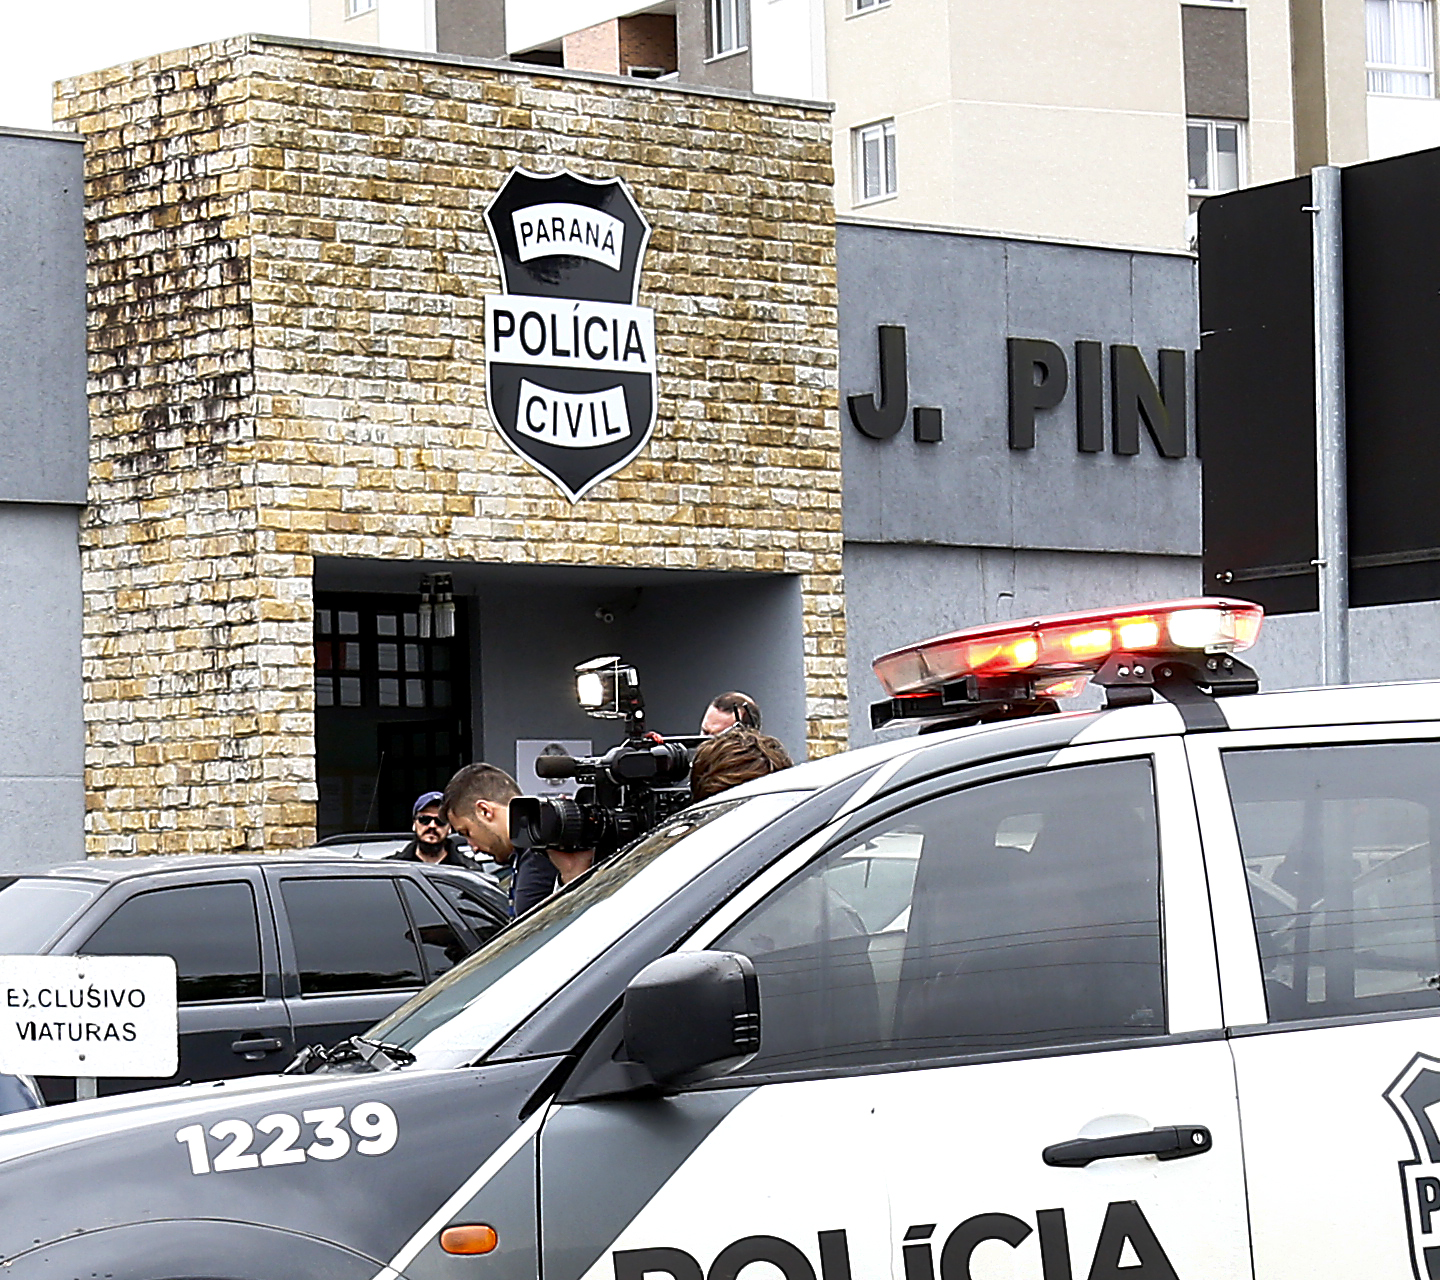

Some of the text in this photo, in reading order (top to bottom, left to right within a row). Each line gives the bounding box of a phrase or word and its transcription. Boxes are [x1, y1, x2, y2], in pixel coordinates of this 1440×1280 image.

[521, 215, 616, 258] PARANÁ
[494, 303, 646, 364] POLÍCIA
[846, 324, 944, 443] J.
[1007, 335, 1203, 459] PIN
[525, 393, 622, 439] CIVIL
[7, 987, 146, 1008] EXCLUSIVO
[15, 1020, 137, 1042] VIATURAS
[175, 1100, 400, 1176] 12239
